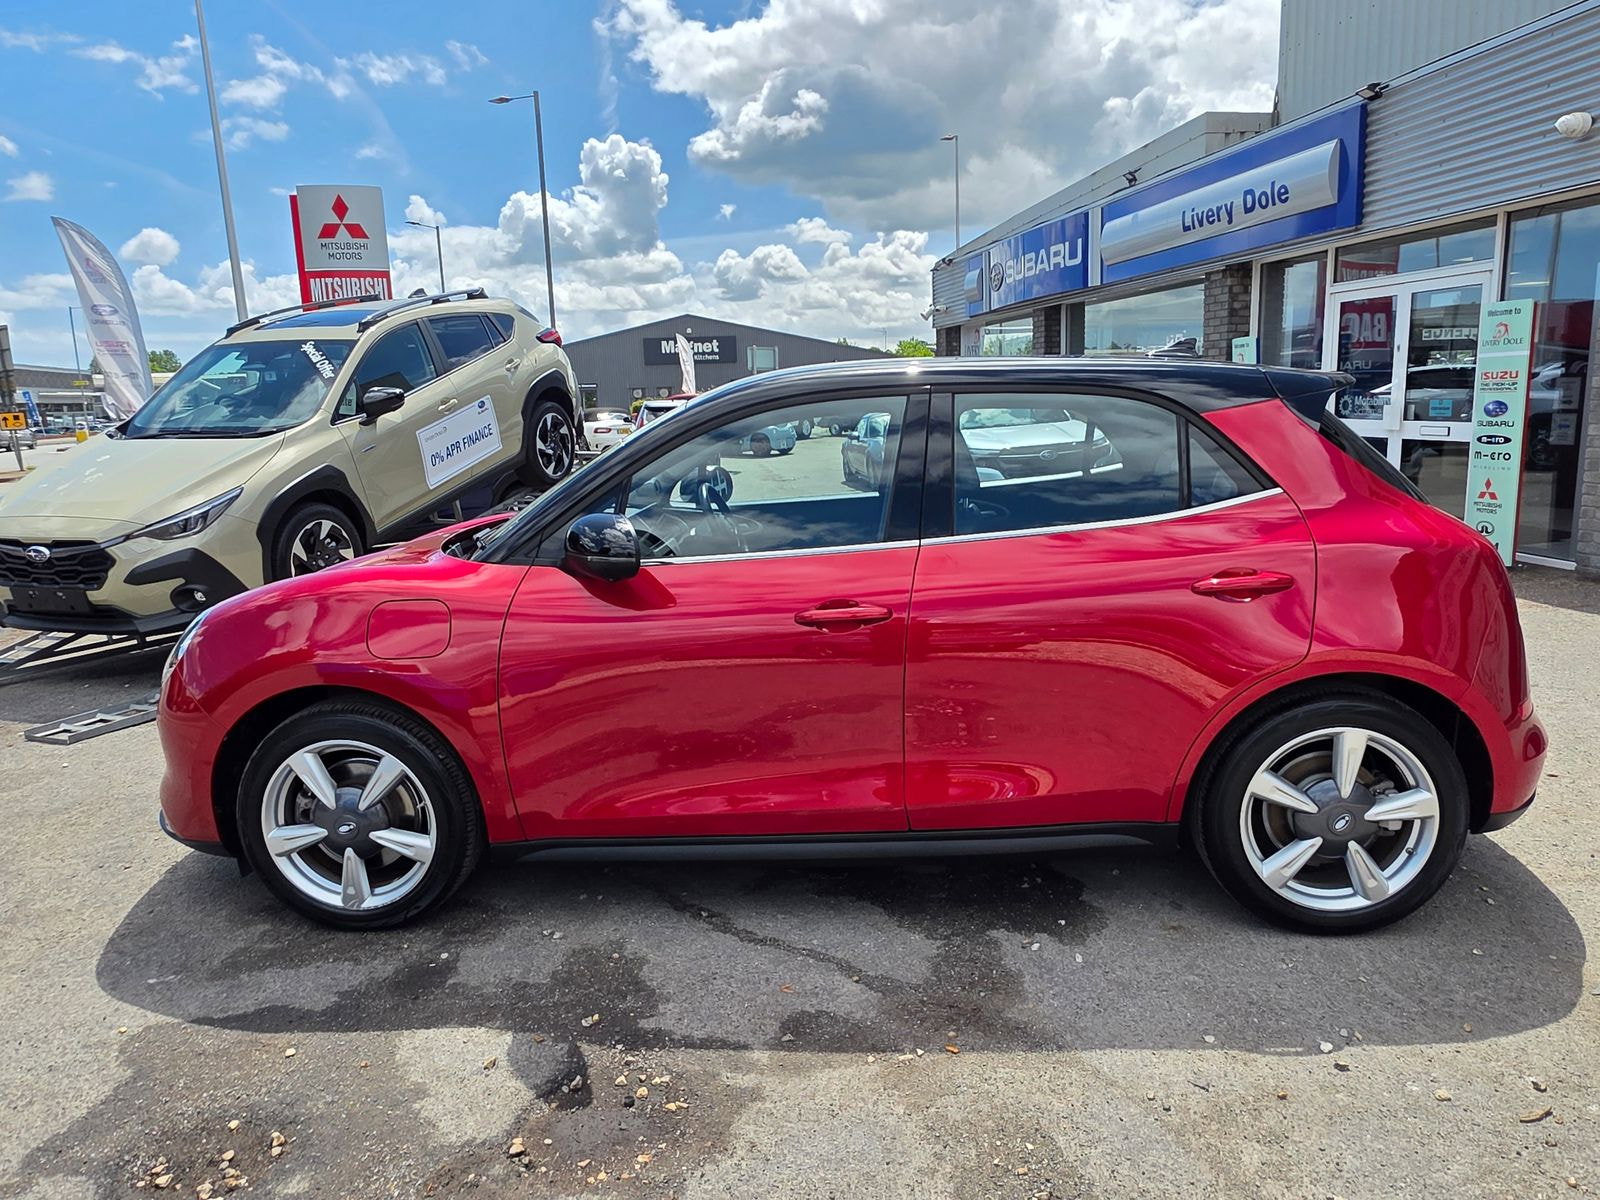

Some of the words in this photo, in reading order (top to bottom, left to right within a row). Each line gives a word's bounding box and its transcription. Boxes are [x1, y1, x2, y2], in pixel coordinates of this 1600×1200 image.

[1181, 201, 1235, 232] Livery
[1242, 180, 1290, 215] Dole
[320, 242, 369, 251] MITSUBISHI
[328, 252, 363, 260] MOTORS
[1004, 238, 1083, 284] SUBARU
[310, 277, 389, 302] MITSUBISHI
[1503, 337, 1525, 346] DOLE
[300, 341, 327, 364] Special
[315, 359, 336, 379] Offer
[1480, 370, 1519, 381] ISUZU
[1477, 420, 1515, 428] SUBARU
[430, 449, 445, 467] 0%
[446, 440, 462, 460] APR
[462, 423, 494, 450] FINANCE
